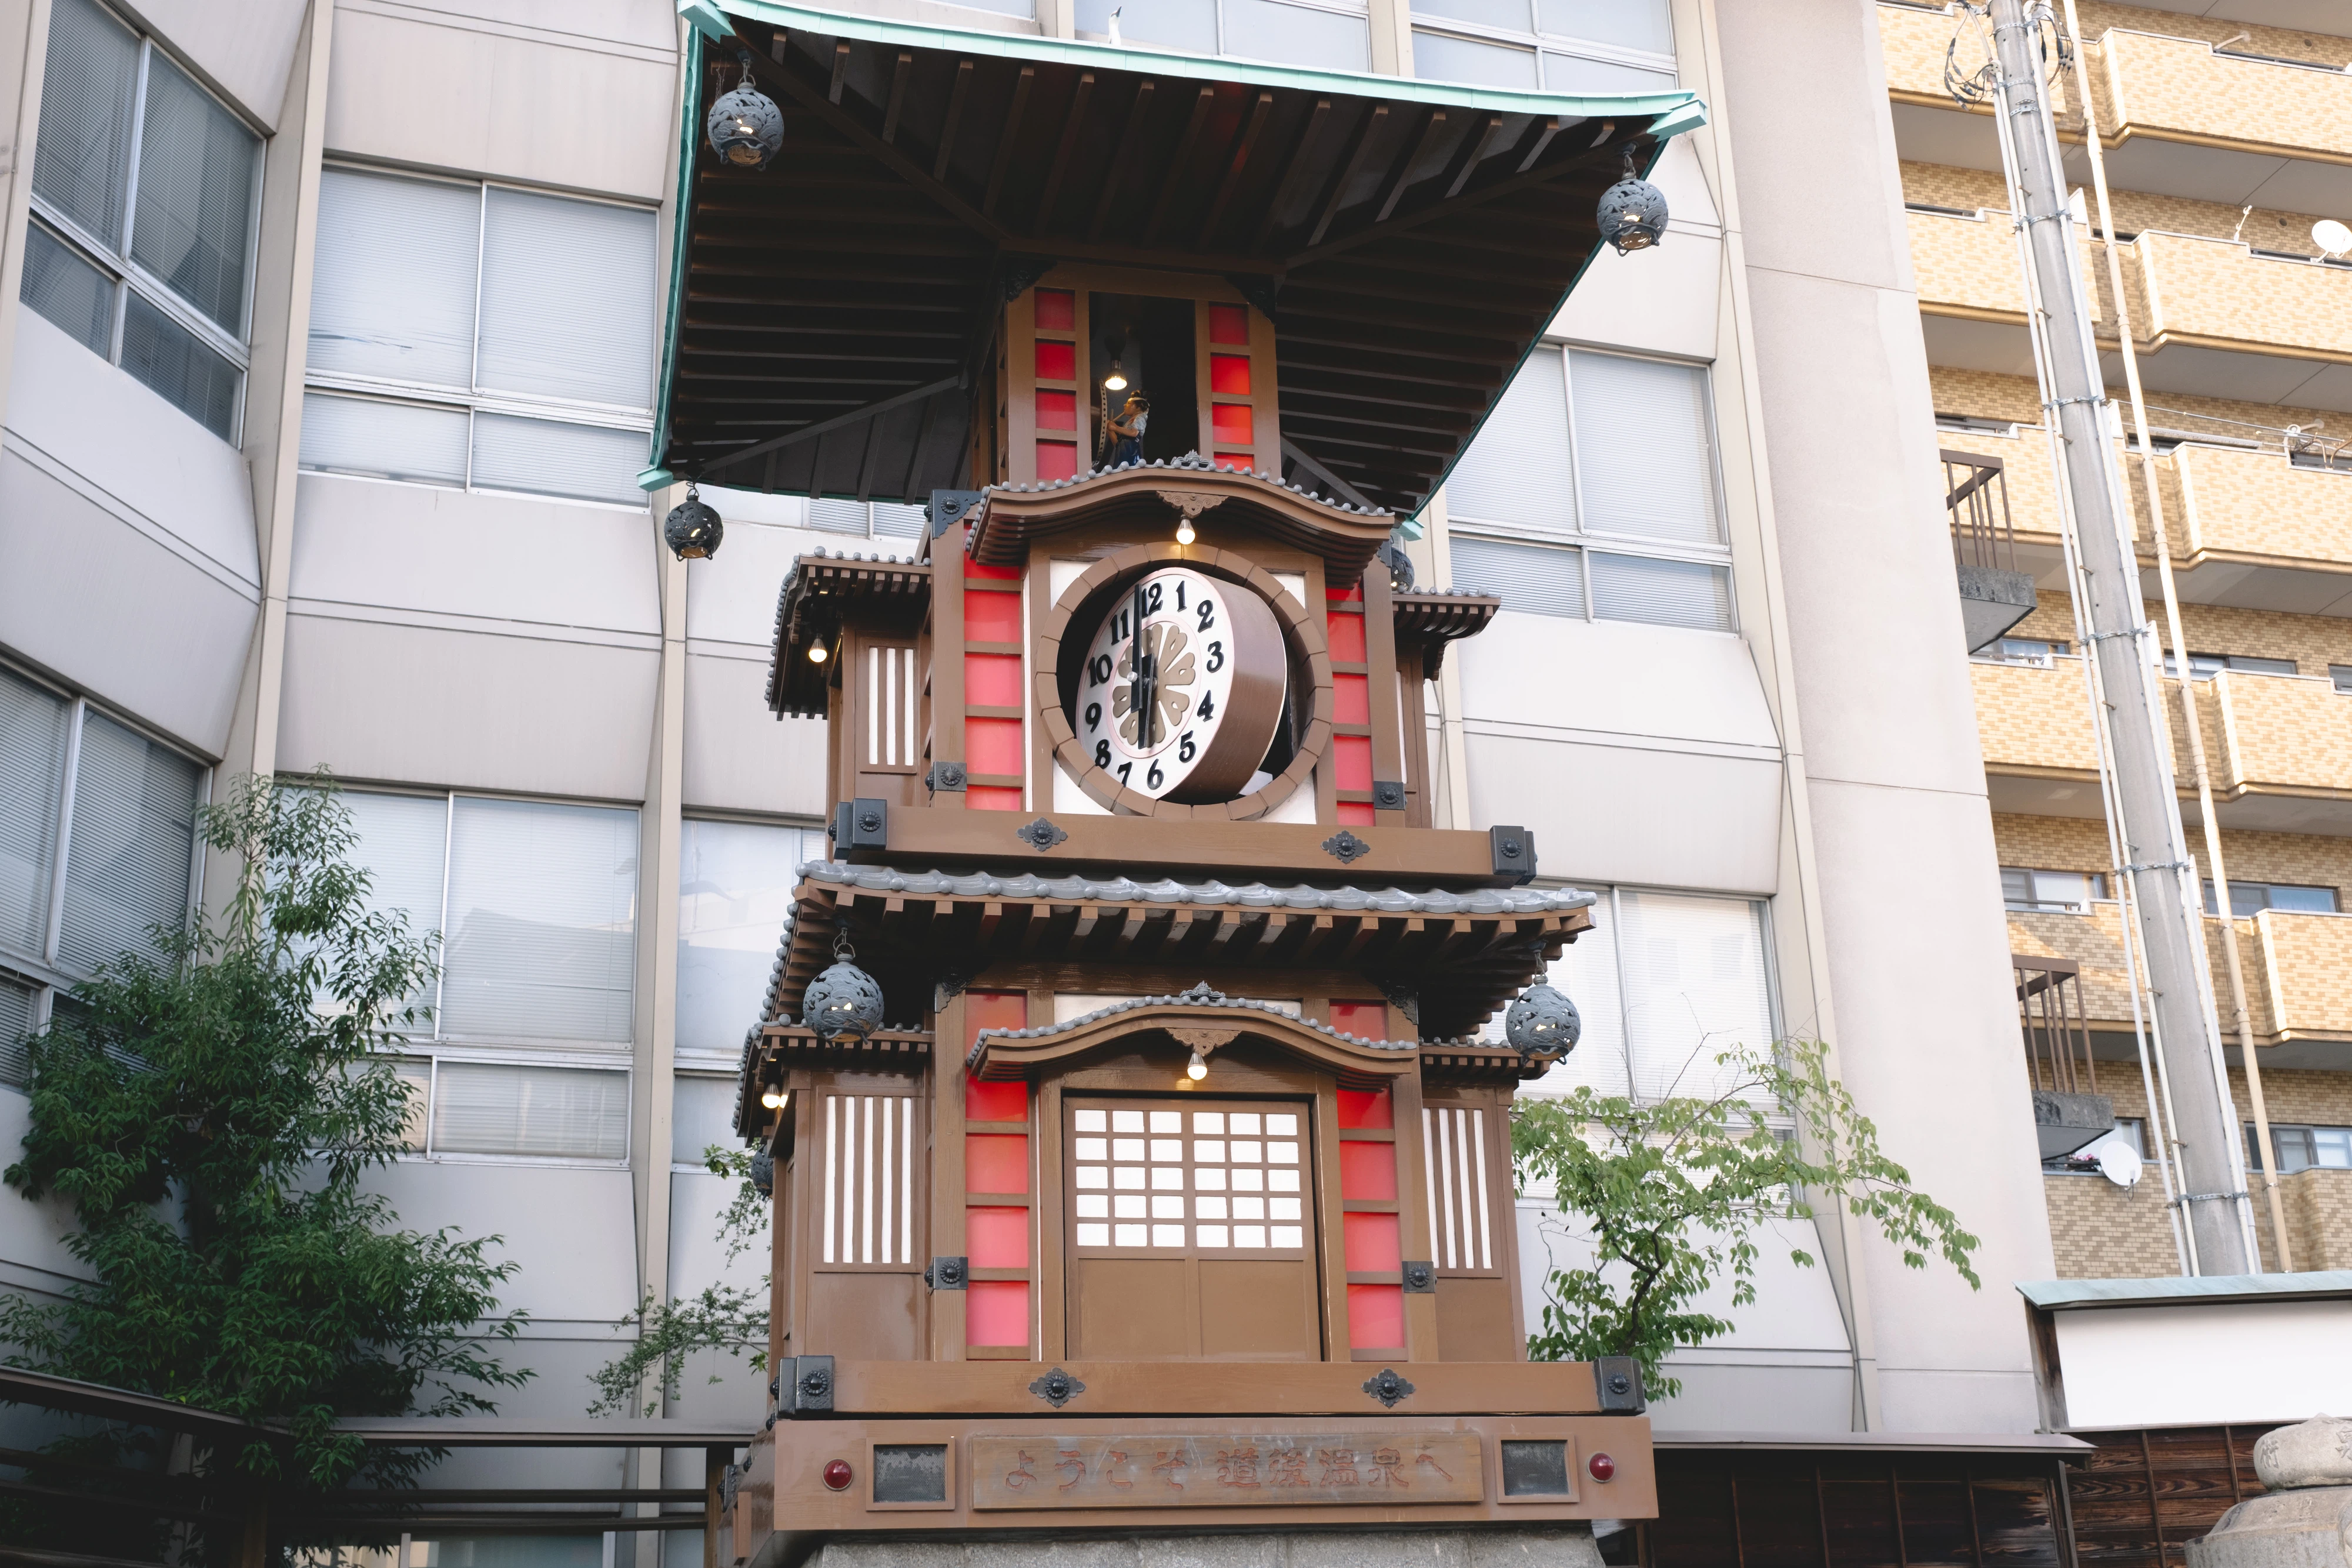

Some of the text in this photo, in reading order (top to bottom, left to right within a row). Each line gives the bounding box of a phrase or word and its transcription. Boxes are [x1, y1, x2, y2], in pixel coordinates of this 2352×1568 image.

[1141, 583, 1163, 618] 12
[1176, 580, 1187, 611] 1
[1110, 609, 1130, 645] 11
[1197, 600, 1214, 632] 2
[1088, 654, 1112, 687] 10
[1207, 641, 1224, 673] 3
[1085, 703, 1102, 733] 9
[1197, 690, 1214, 722] 4
[1095, 739, 1111, 769] 8
[1179, 730, 1196, 763] 5
[1117, 761, 1132, 787] 7
[1147, 759, 1164, 790] 6
[1005, 1447, 1453, 1490] ようこそ道後温泉へ
